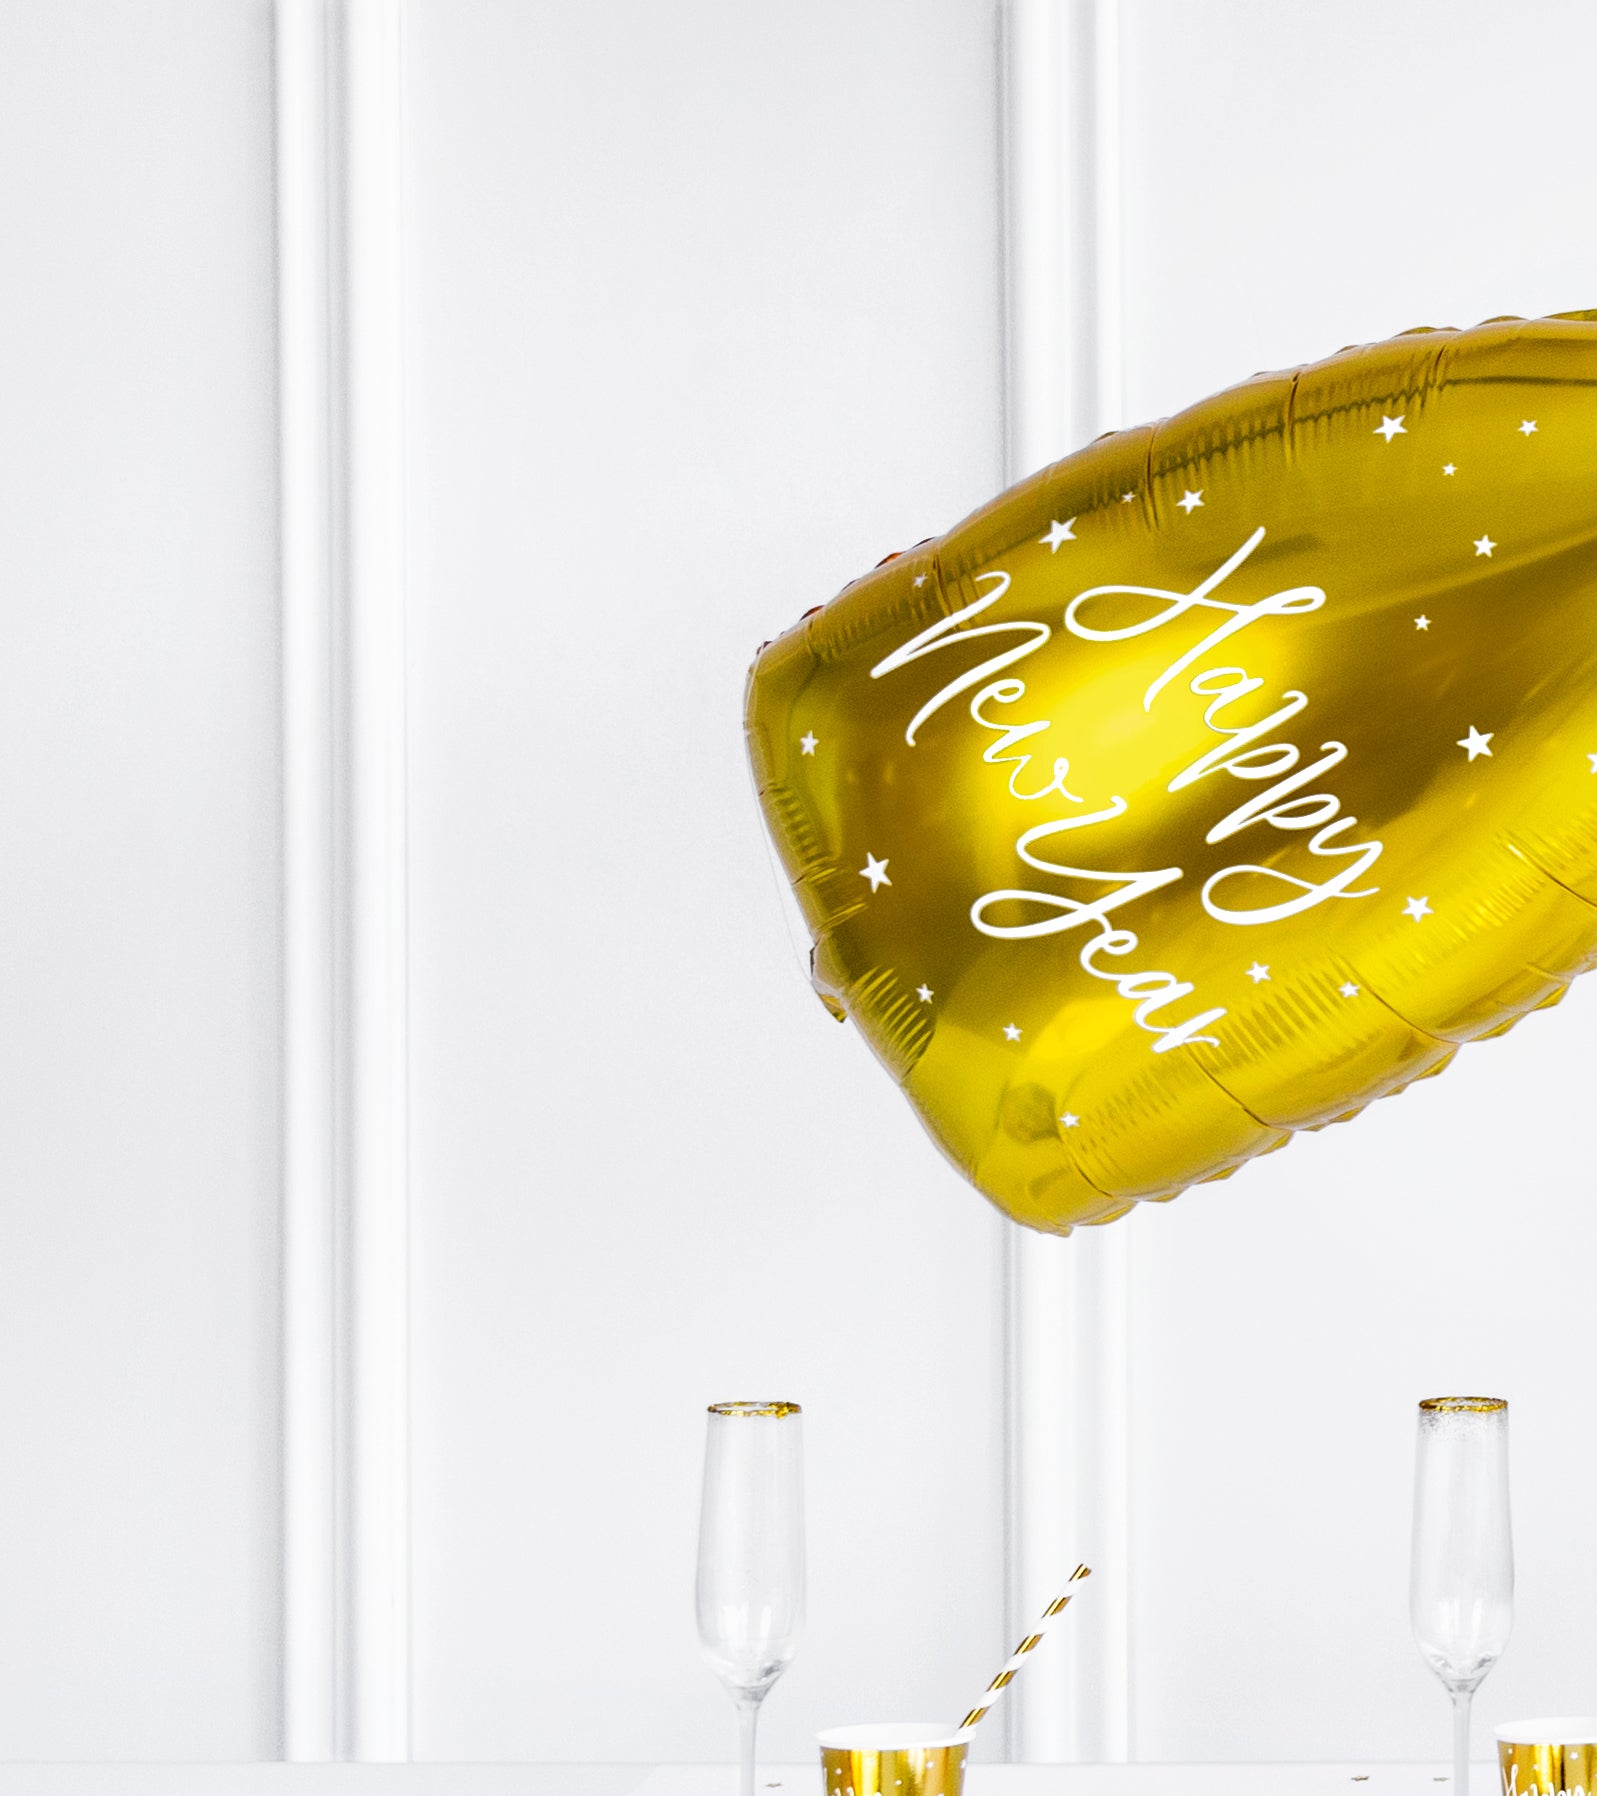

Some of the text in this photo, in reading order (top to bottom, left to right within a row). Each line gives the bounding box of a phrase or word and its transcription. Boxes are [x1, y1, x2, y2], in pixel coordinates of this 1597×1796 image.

[870, 571, 1227, 1054] New Year
[1063, 526, 1384, 926] Happy
